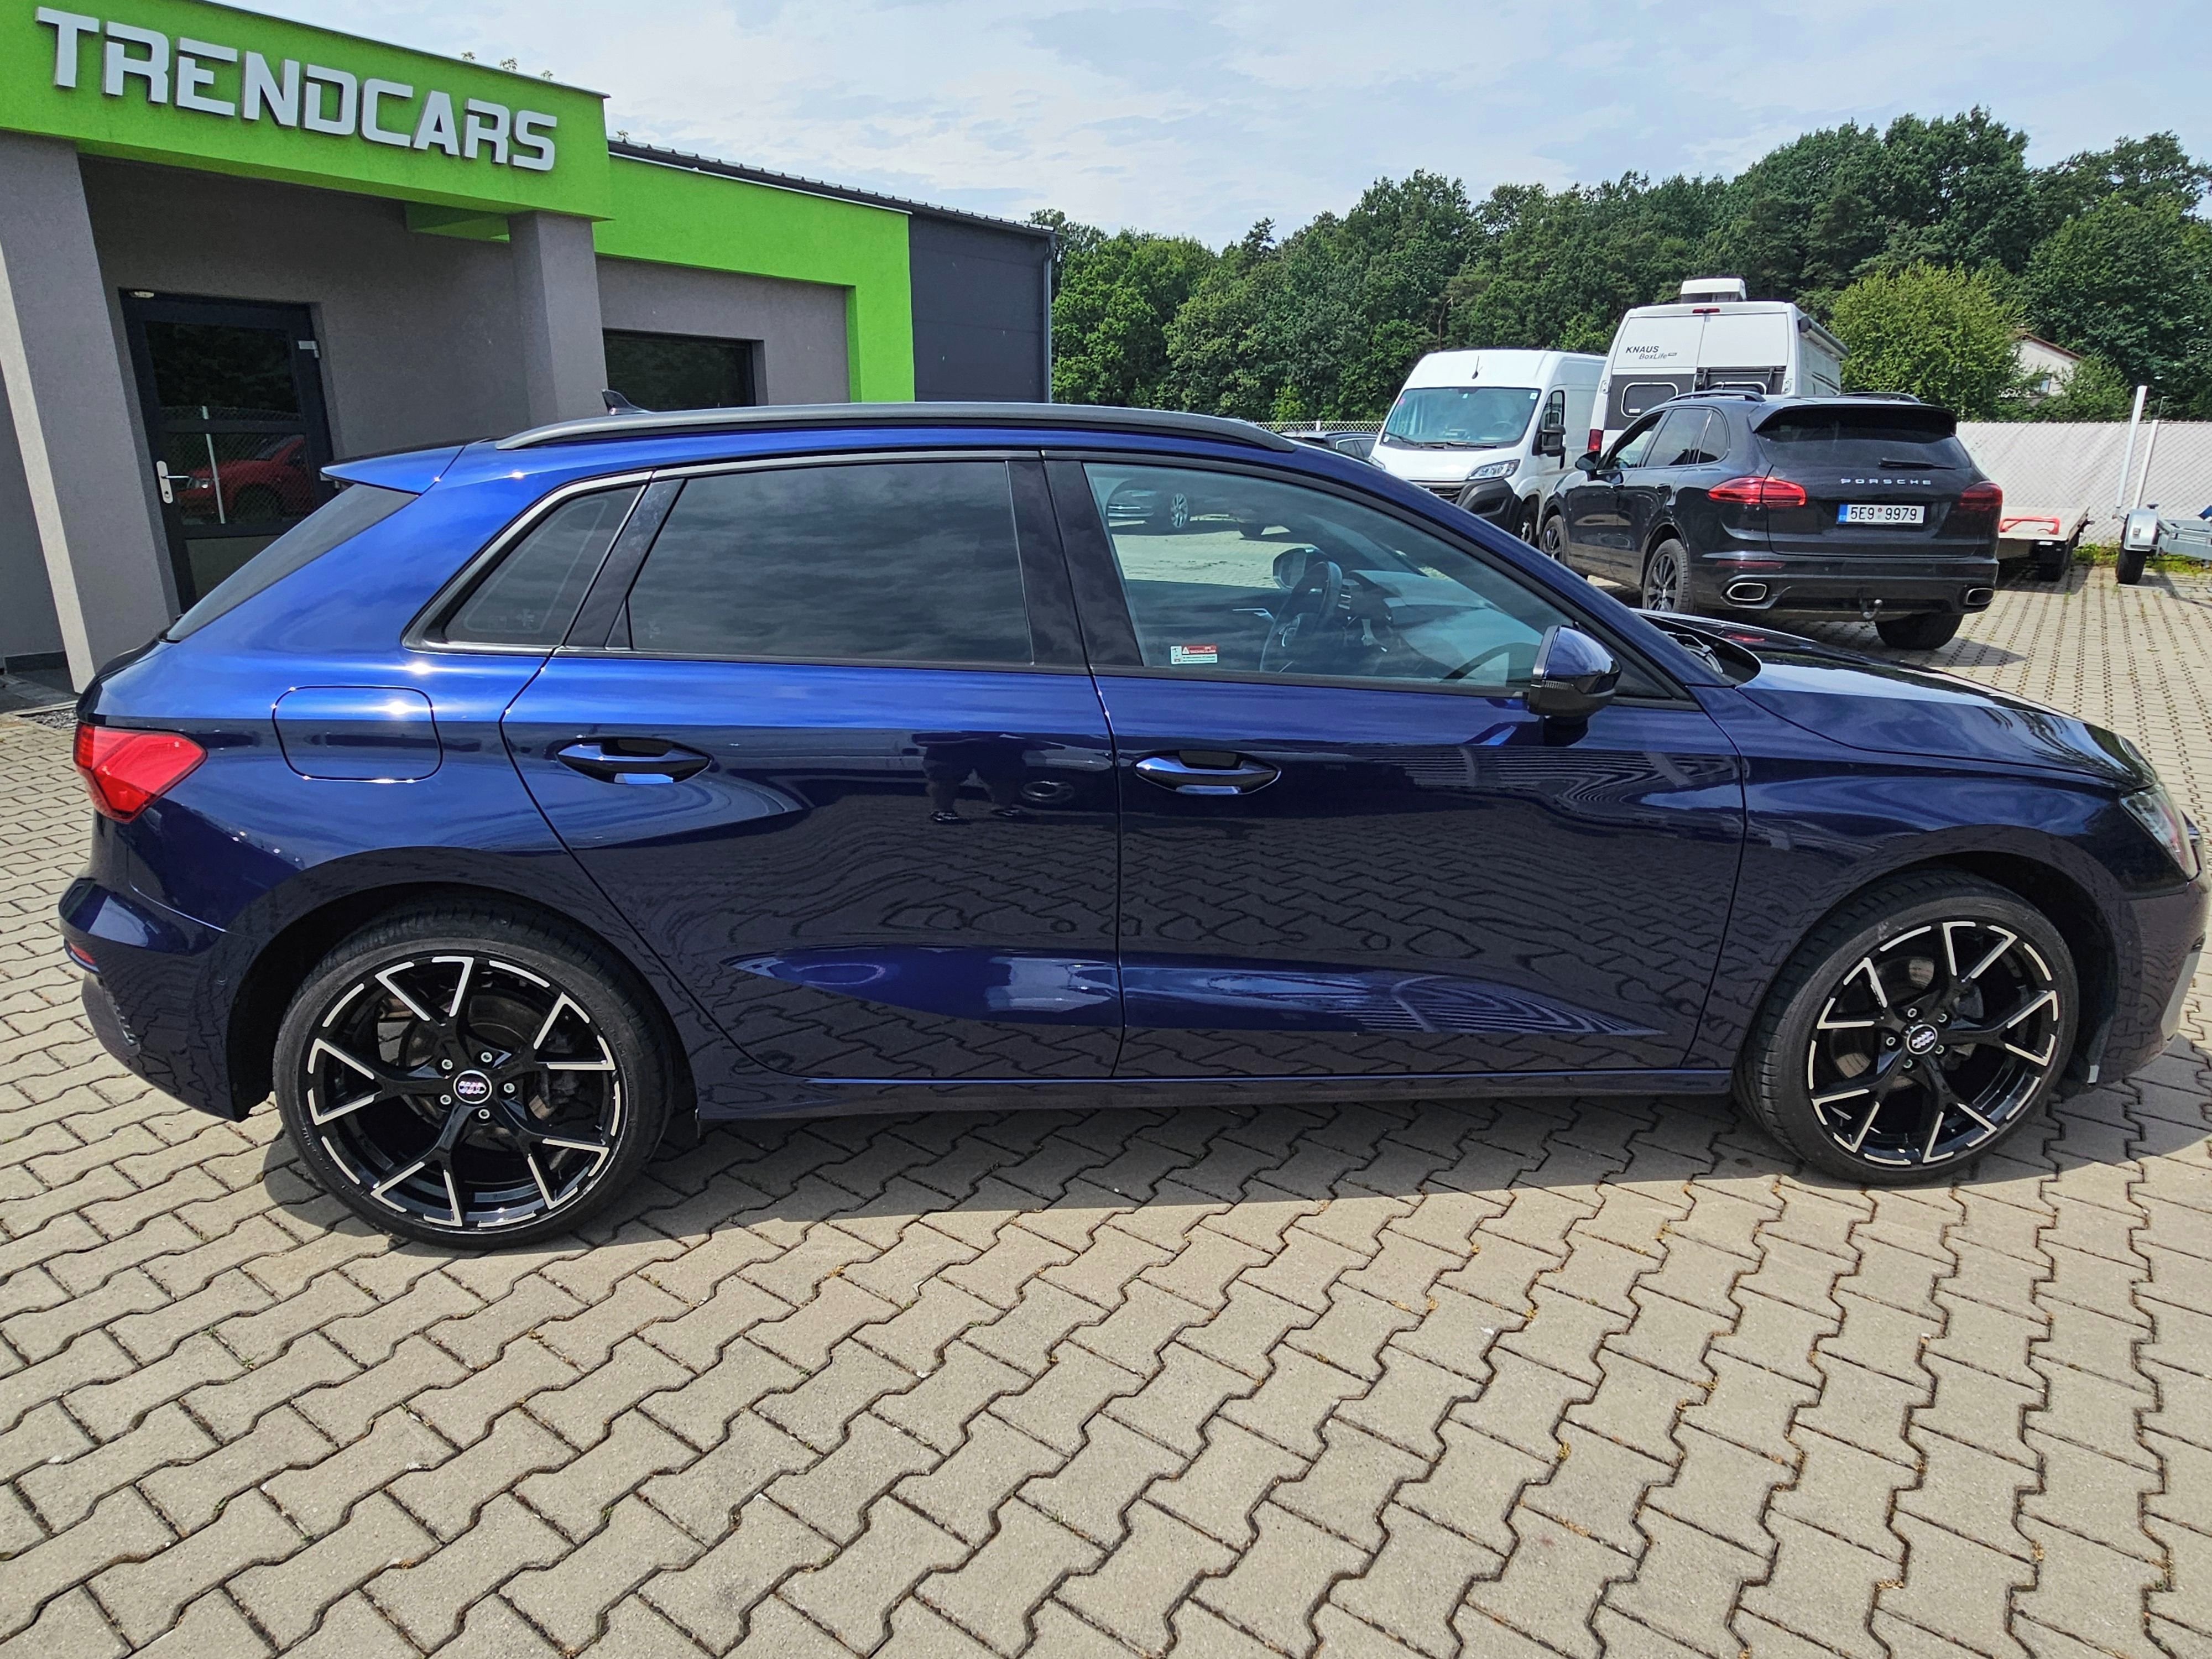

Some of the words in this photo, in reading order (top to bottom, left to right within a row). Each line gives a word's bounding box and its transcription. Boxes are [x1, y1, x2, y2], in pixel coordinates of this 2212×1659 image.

[36, 6, 557, 171] TRENDCARS
[1850, 507, 1874, 520] 5E9
[1885, 507, 1917, 520] 9979
